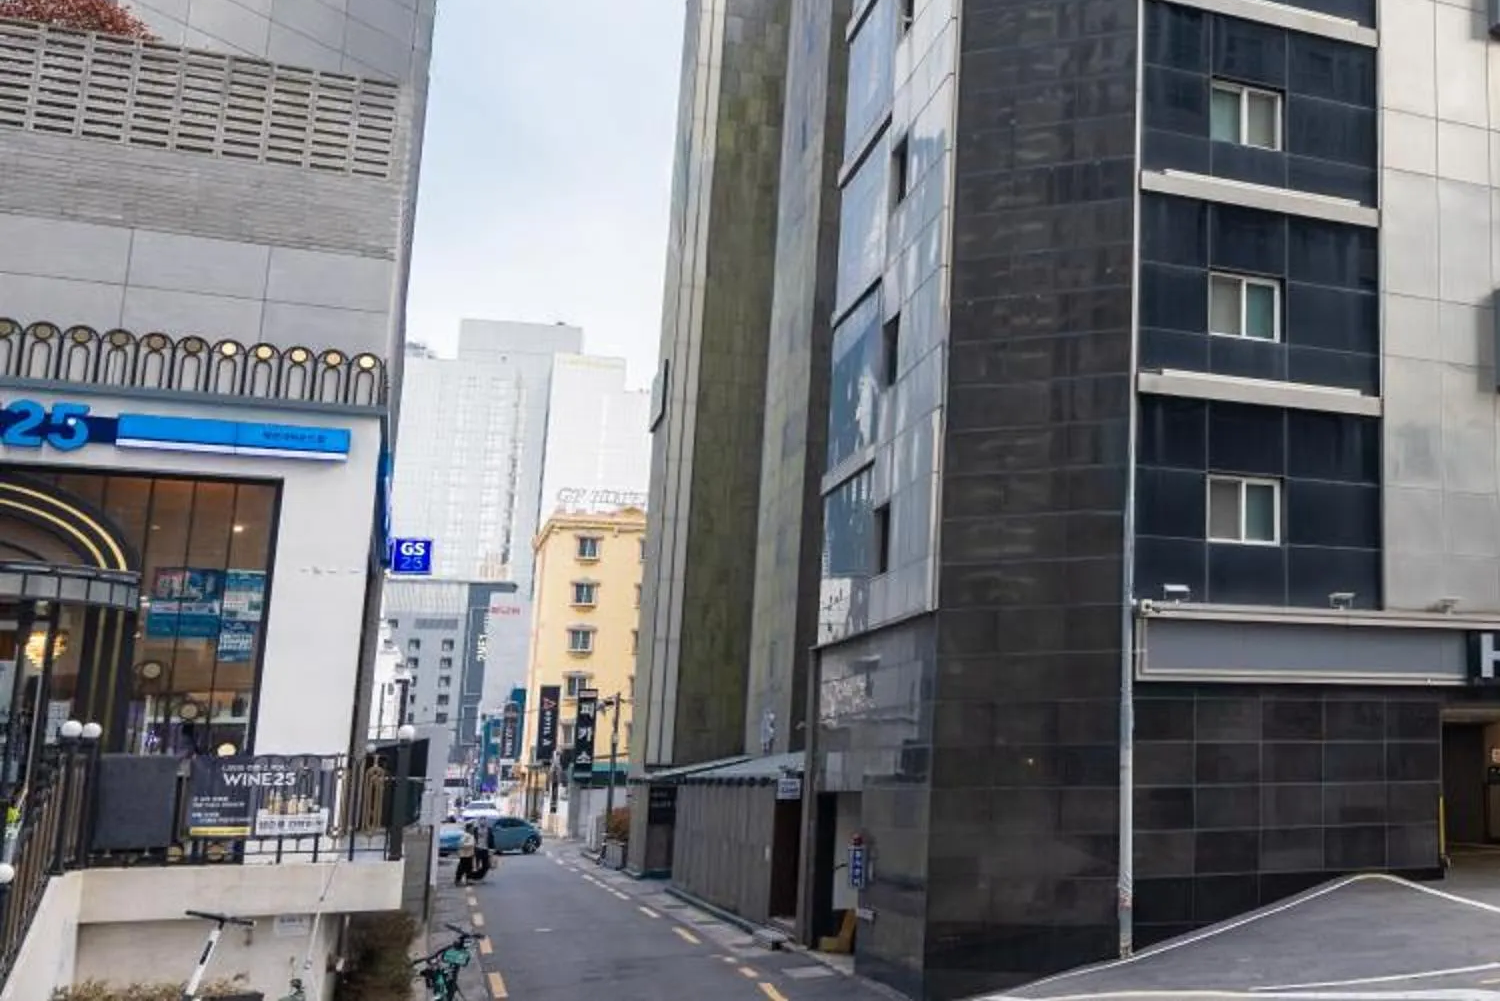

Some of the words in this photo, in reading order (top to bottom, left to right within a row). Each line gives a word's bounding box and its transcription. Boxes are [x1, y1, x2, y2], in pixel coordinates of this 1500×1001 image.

[0, 399, 90, 452] 25
[401, 542, 425, 556] GS
[400, 557, 423, 569] 25
[223, 772, 297, 786] WINE25
